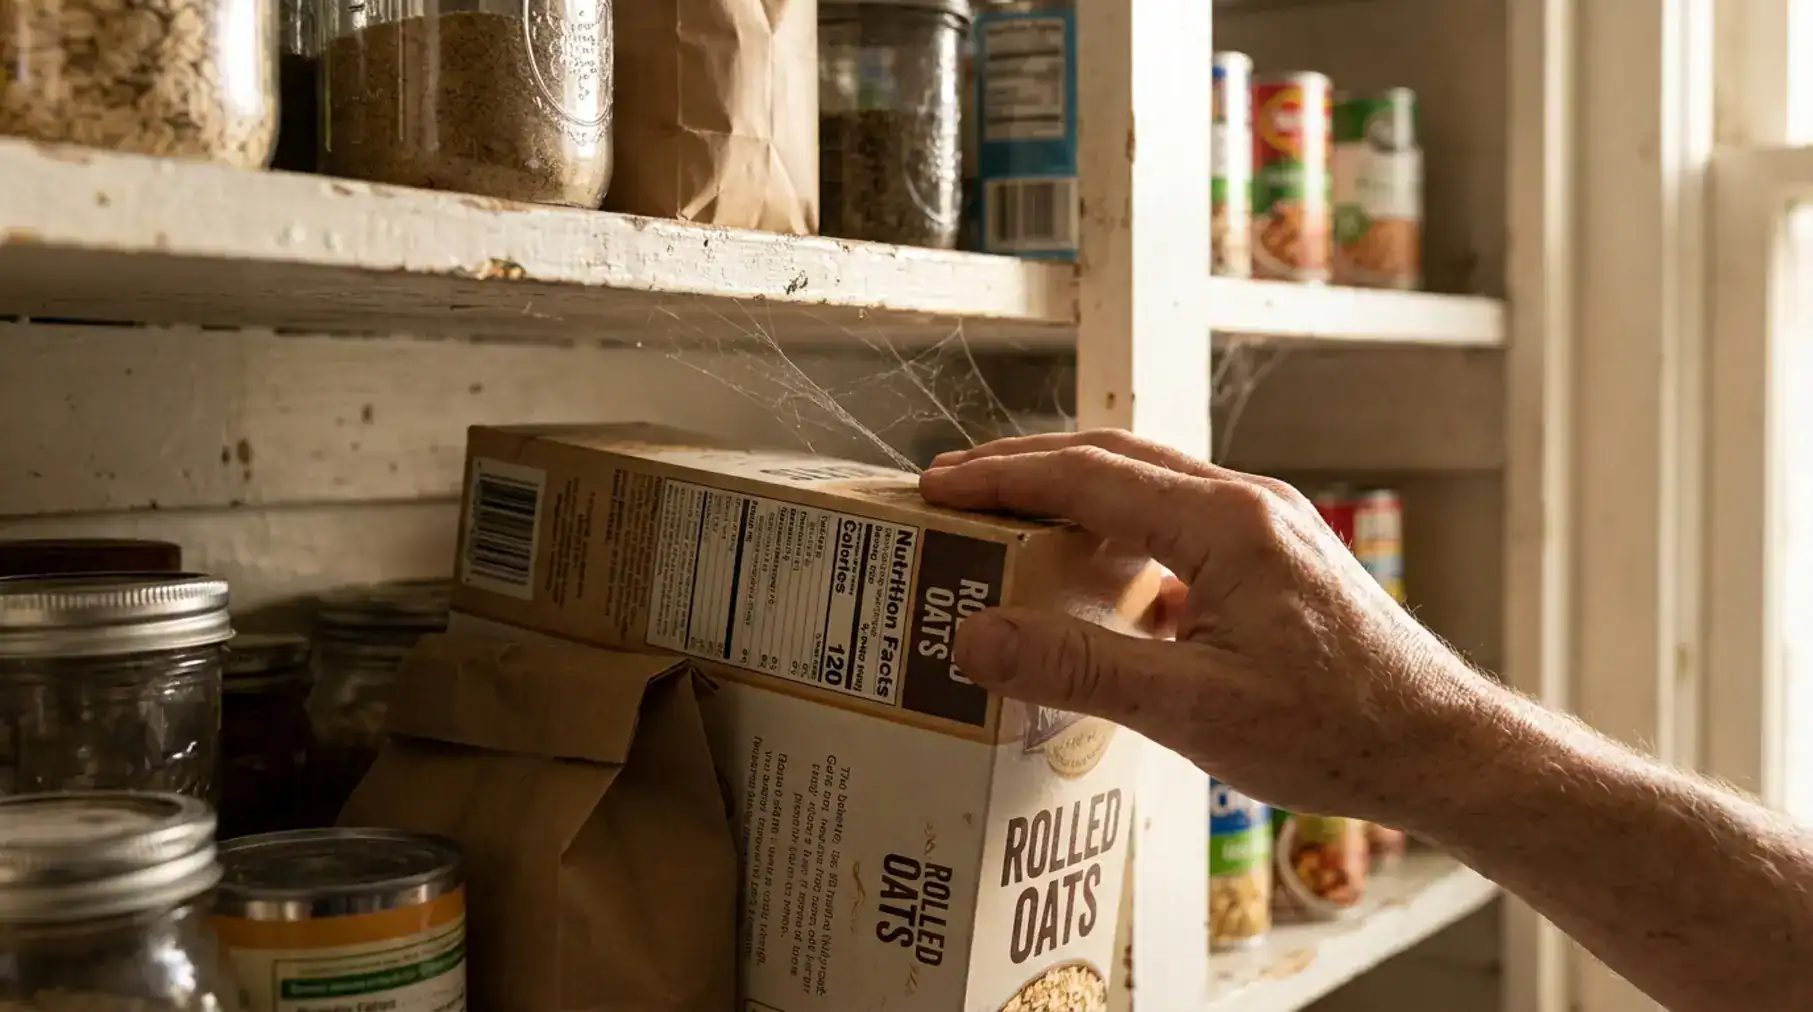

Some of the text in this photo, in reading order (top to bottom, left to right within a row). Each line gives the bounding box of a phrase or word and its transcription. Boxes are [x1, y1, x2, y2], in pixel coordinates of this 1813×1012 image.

[825, 643, 846, 686] 120
[918, 586, 955, 660] OATS
[1000, 787, 1122, 888] ROLLED
[875, 852, 922, 948] OATS
[914, 862, 953, 967] ROLLED
[1009, 862, 1102, 965] OATS
